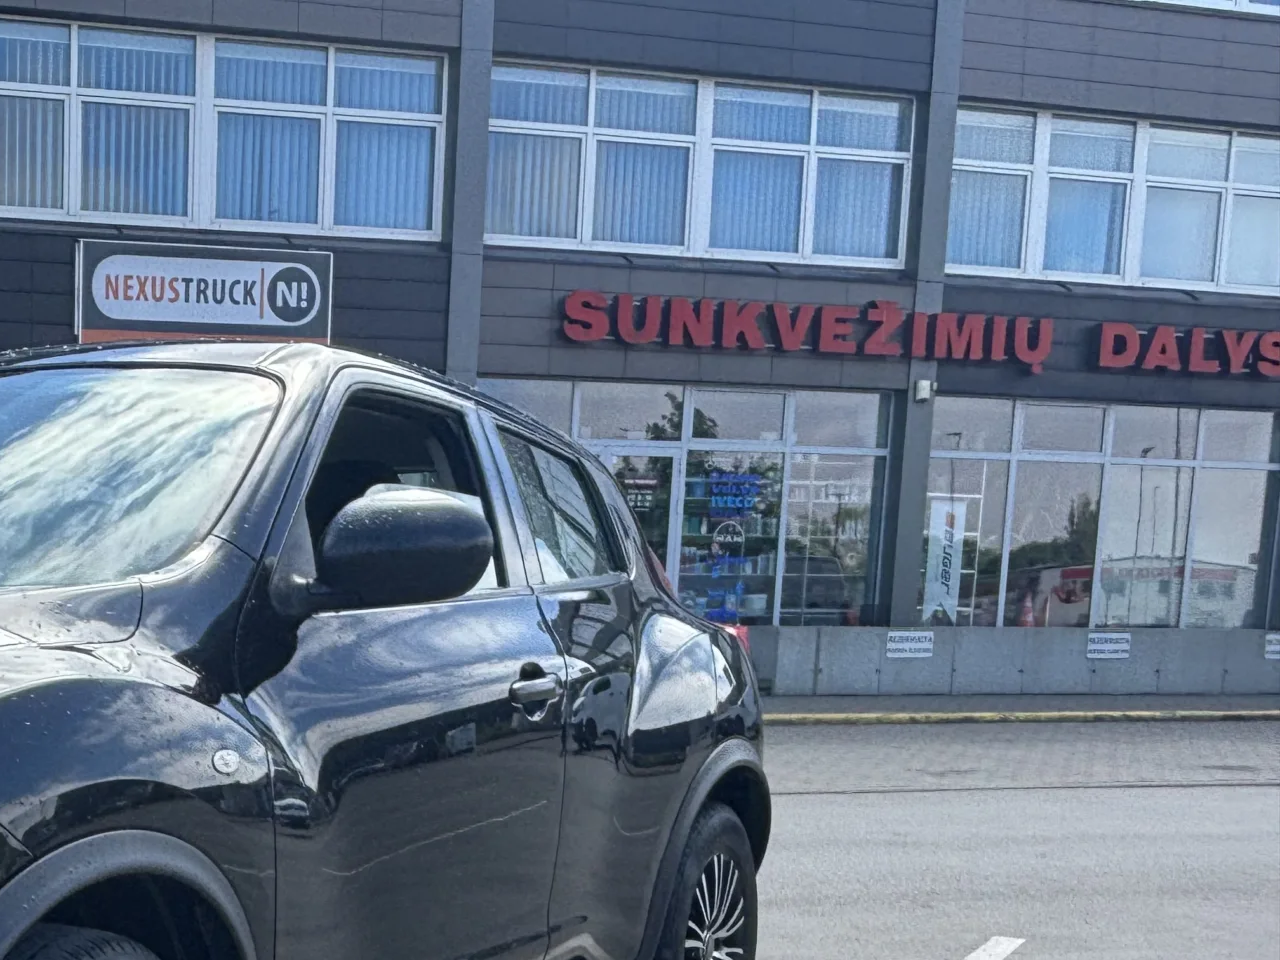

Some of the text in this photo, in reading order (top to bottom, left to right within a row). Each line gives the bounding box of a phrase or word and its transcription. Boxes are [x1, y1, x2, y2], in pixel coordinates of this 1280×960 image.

[105, 273, 308, 308] NEXUSTRUCK N!
[563, 289, 1280, 377] SUNKVEŽIMIŲ DALYS
[712, 496, 754, 507] IVECO
